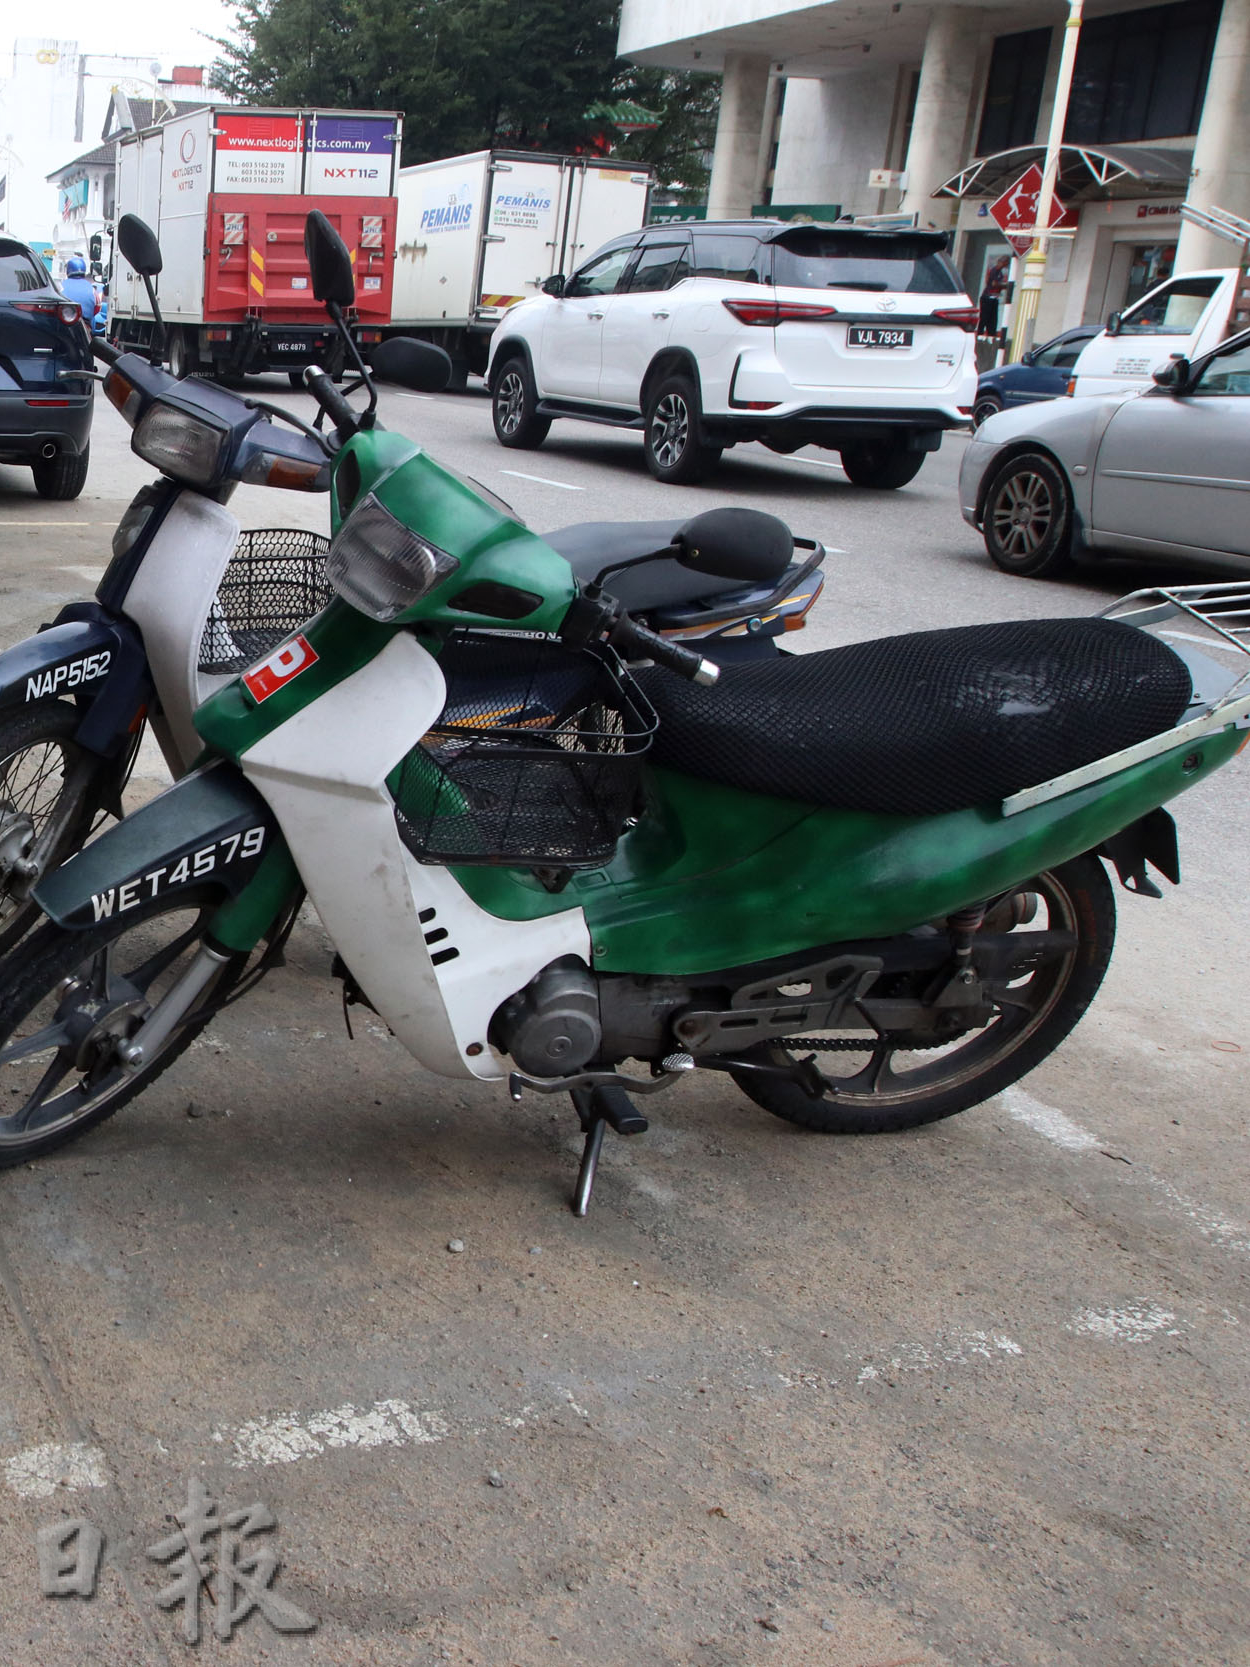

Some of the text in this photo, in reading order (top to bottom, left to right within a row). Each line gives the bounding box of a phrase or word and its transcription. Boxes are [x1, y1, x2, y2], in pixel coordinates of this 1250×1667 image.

[324, 168, 379, 179] NXT112
[496, 195, 551, 208] PEMANIS
[420, 203, 472, 228] PEMANIS
[857, 330, 905, 344] VJL 7934
[277, 343, 306, 351] VEC 4879
[526, 631, 562, 641] HON
[248, 639, 306, 678] P
[25, 650, 111, 703] NAP5152
[90, 825, 266, 923] WET4579
